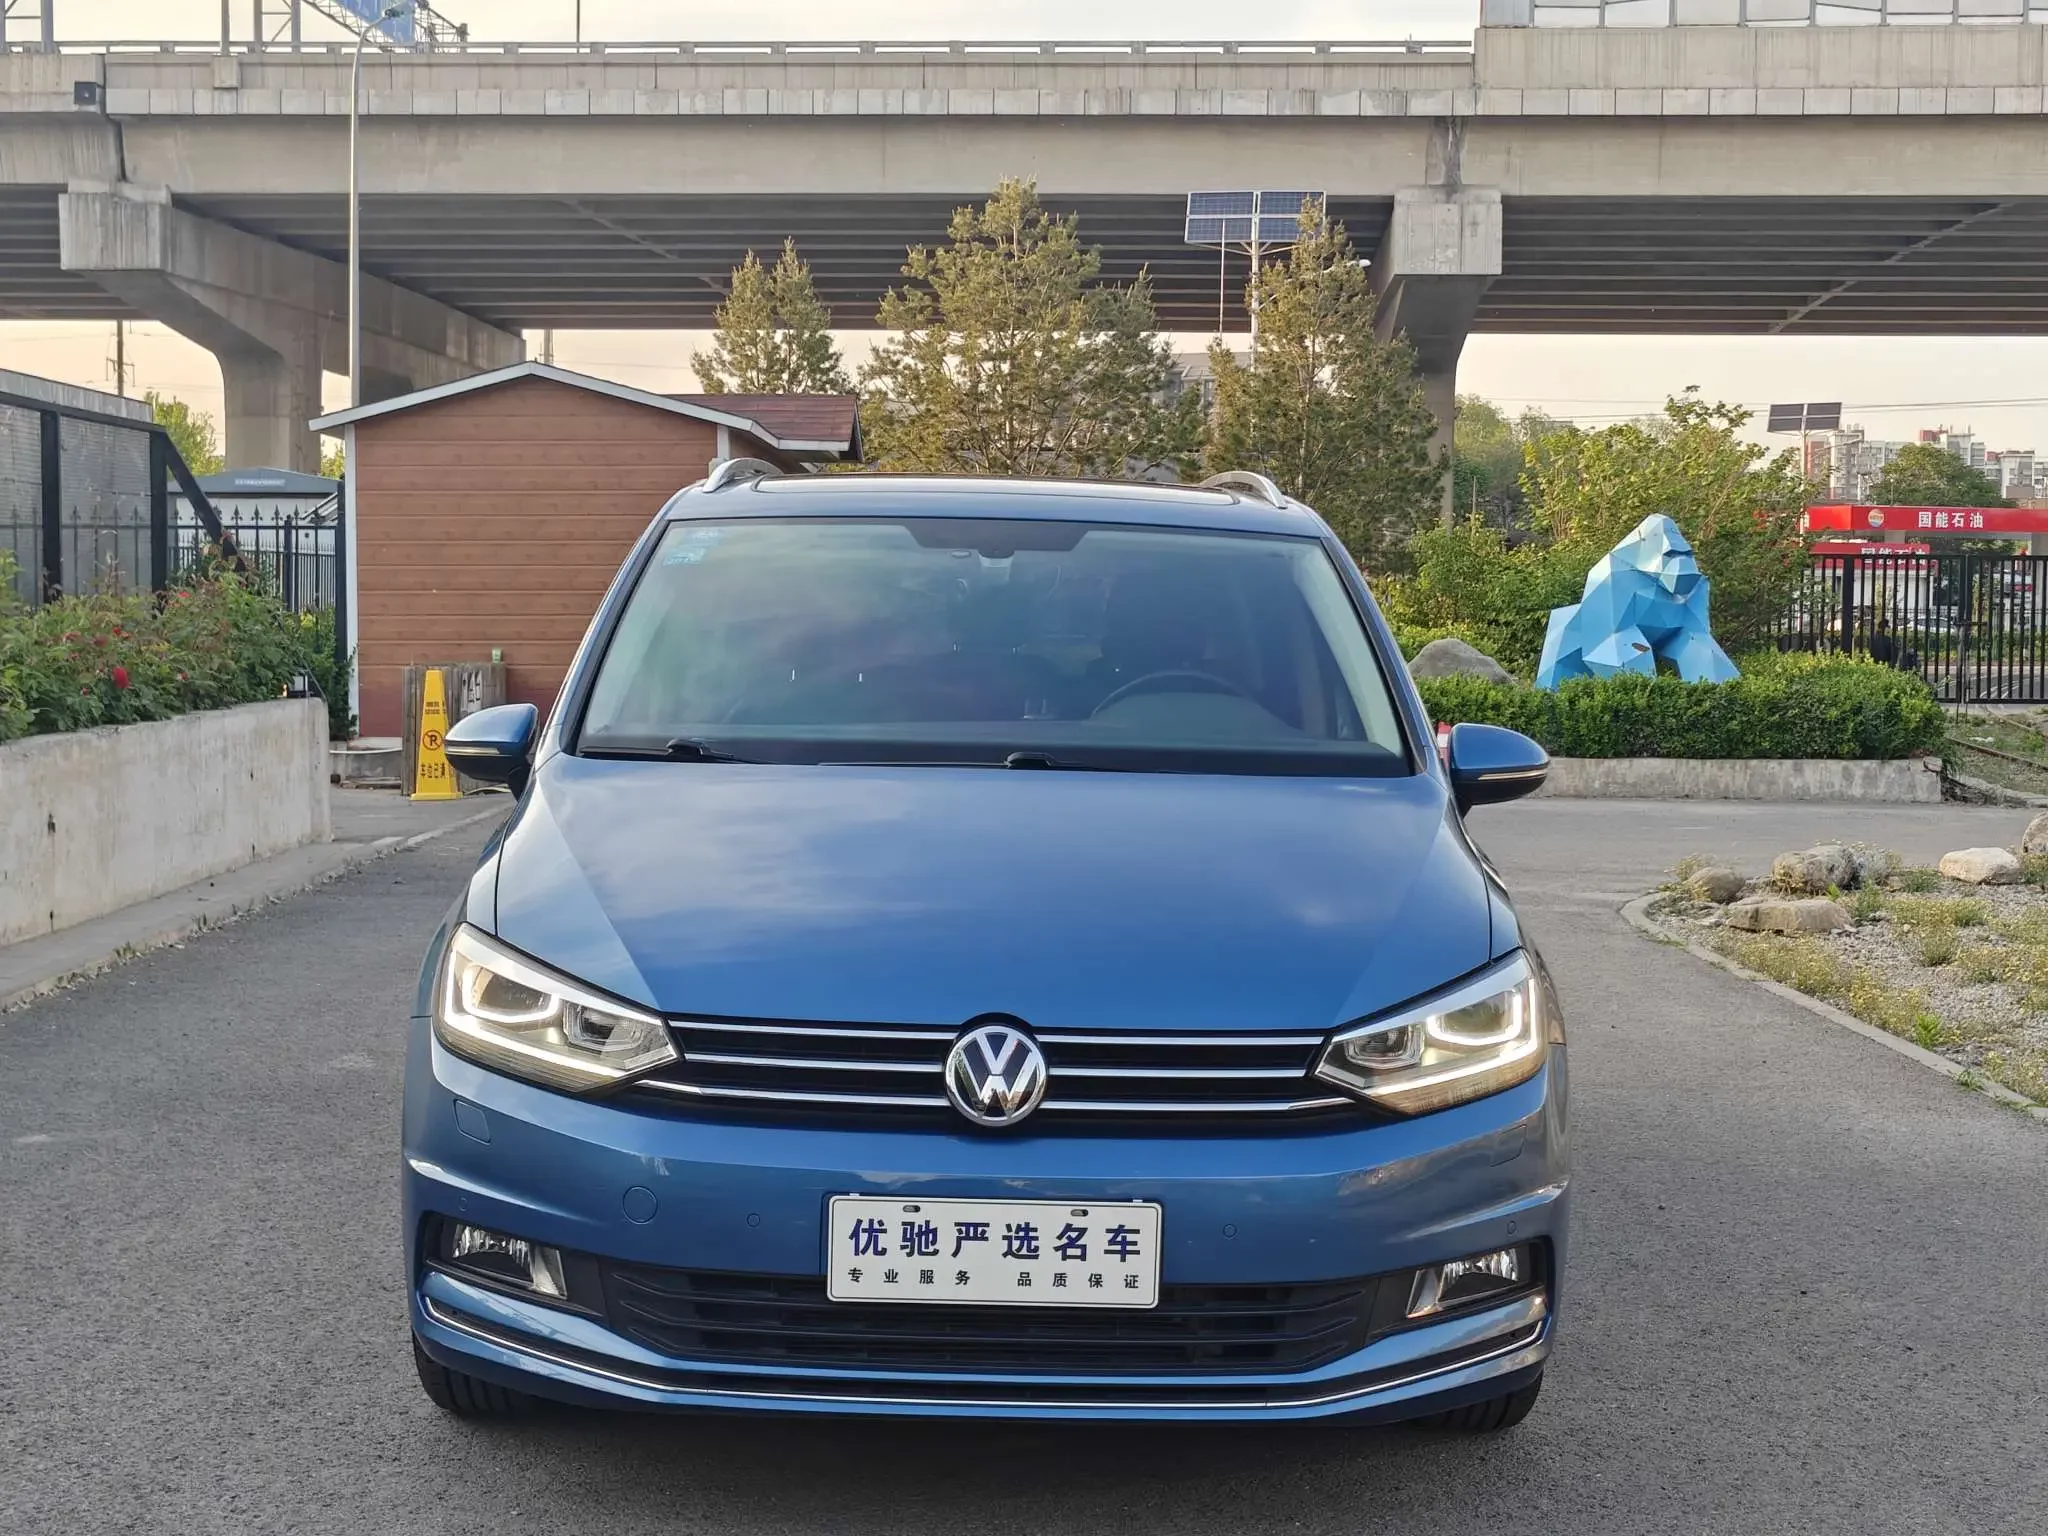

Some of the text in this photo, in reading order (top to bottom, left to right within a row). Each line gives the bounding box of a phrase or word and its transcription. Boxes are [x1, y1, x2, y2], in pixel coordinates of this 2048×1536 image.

[1918, 511, 1984, 529] 国能石油
[849, 1218, 1141, 1262] 优驰严选名车
[848, 1267, 1139, 1289] 专业服务 品质保证
